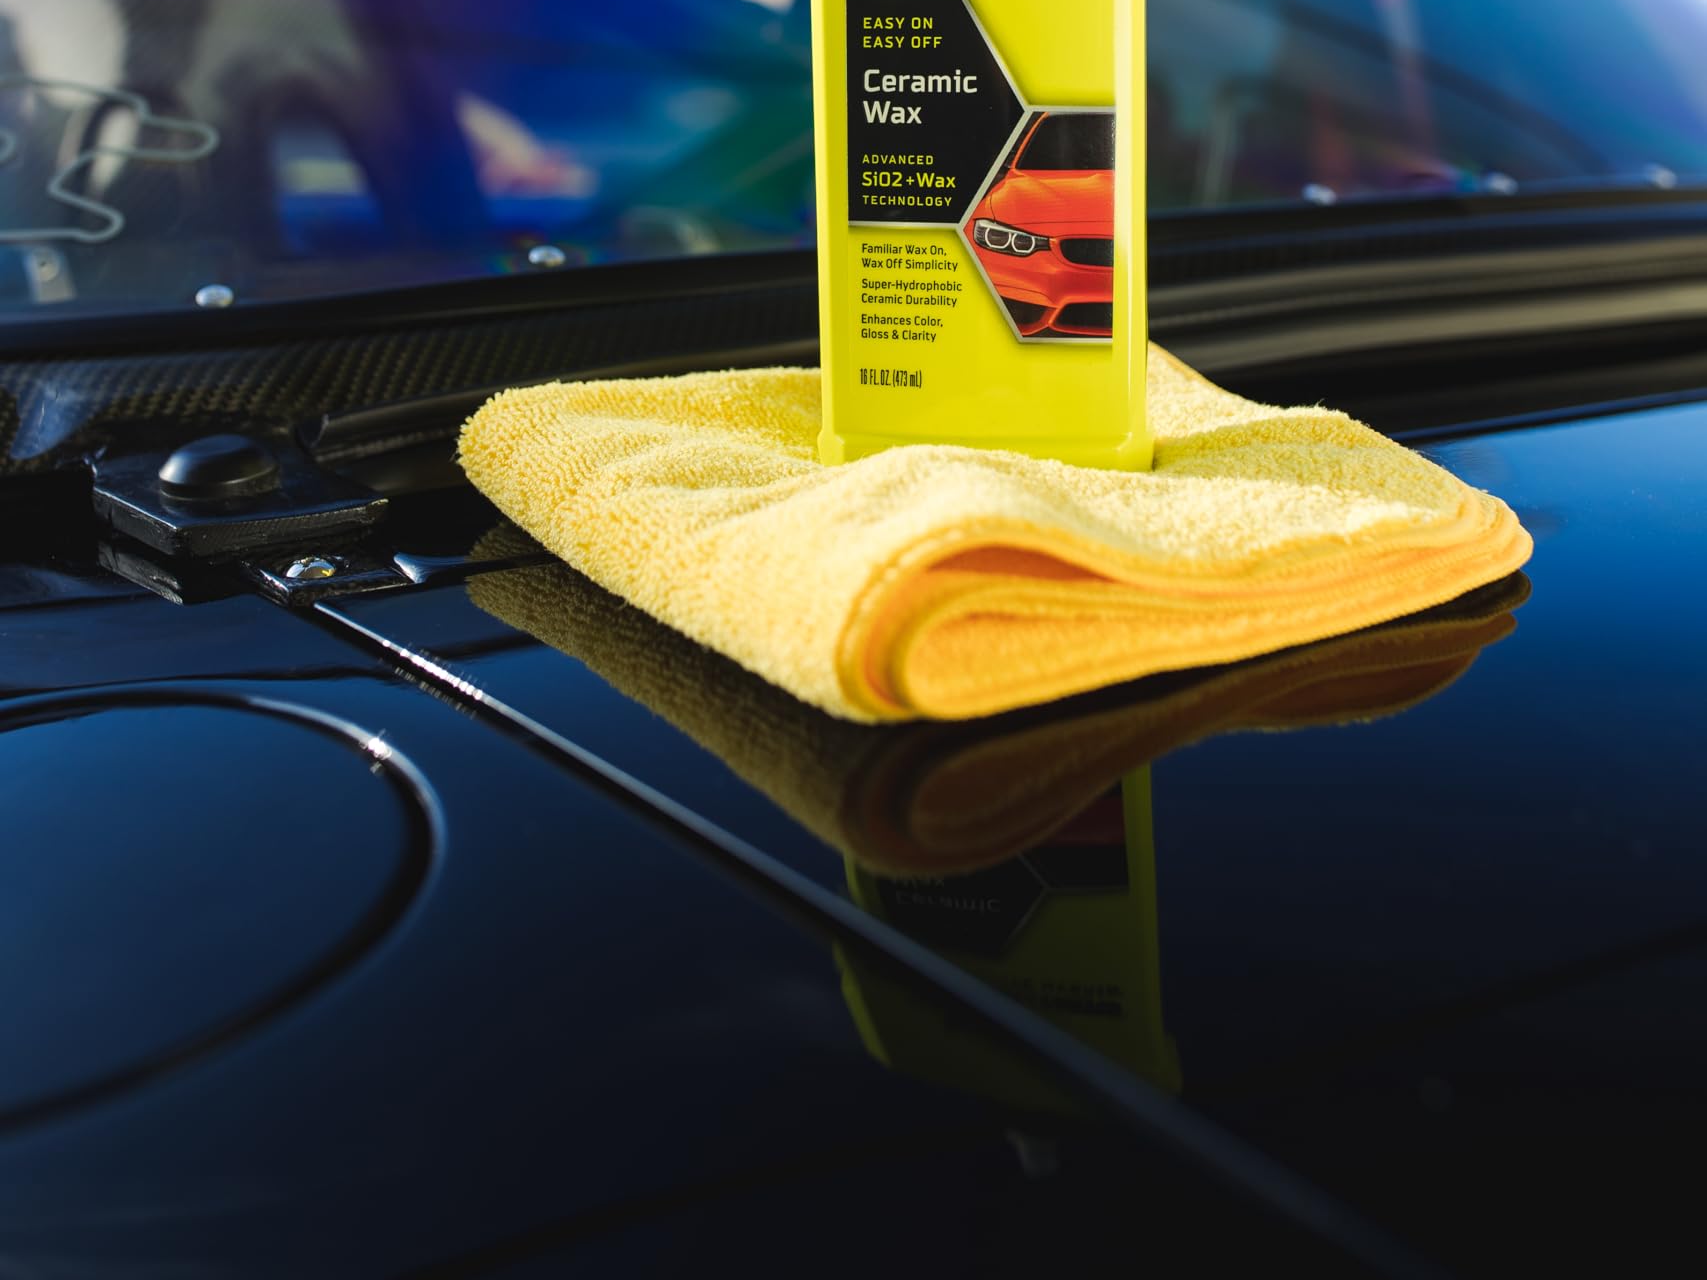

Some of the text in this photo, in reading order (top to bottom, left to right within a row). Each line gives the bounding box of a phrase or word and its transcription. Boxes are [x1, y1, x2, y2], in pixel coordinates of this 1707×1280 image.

[863, 17, 933, 29] EASY ON
[863, 36, 942, 48] EASY OFF
[864, 69, 978, 93] Ceramic
[863, 101, 922, 124] Wax
[862, 154, 934, 165] ADVANCED
[862, 195, 952, 207] TECHNOLOGY
[861, 243, 947, 257] Familiar Wax On,
[861, 258, 958, 272] Wax Off Simplicity
[861, 278, 962, 292] Super-Hydrophobic
[861, 293, 957, 307] Ceramic Durability
[861, 314, 943, 328] Enhances Color,
[861, 329, 936, 342] Gloss & Clarity
[860, 369, 867, 385] 16
[869, 369, 880, 385] FL.
[892, 369, 907, 388] (473
[909, 371, 922, 388] mL)
